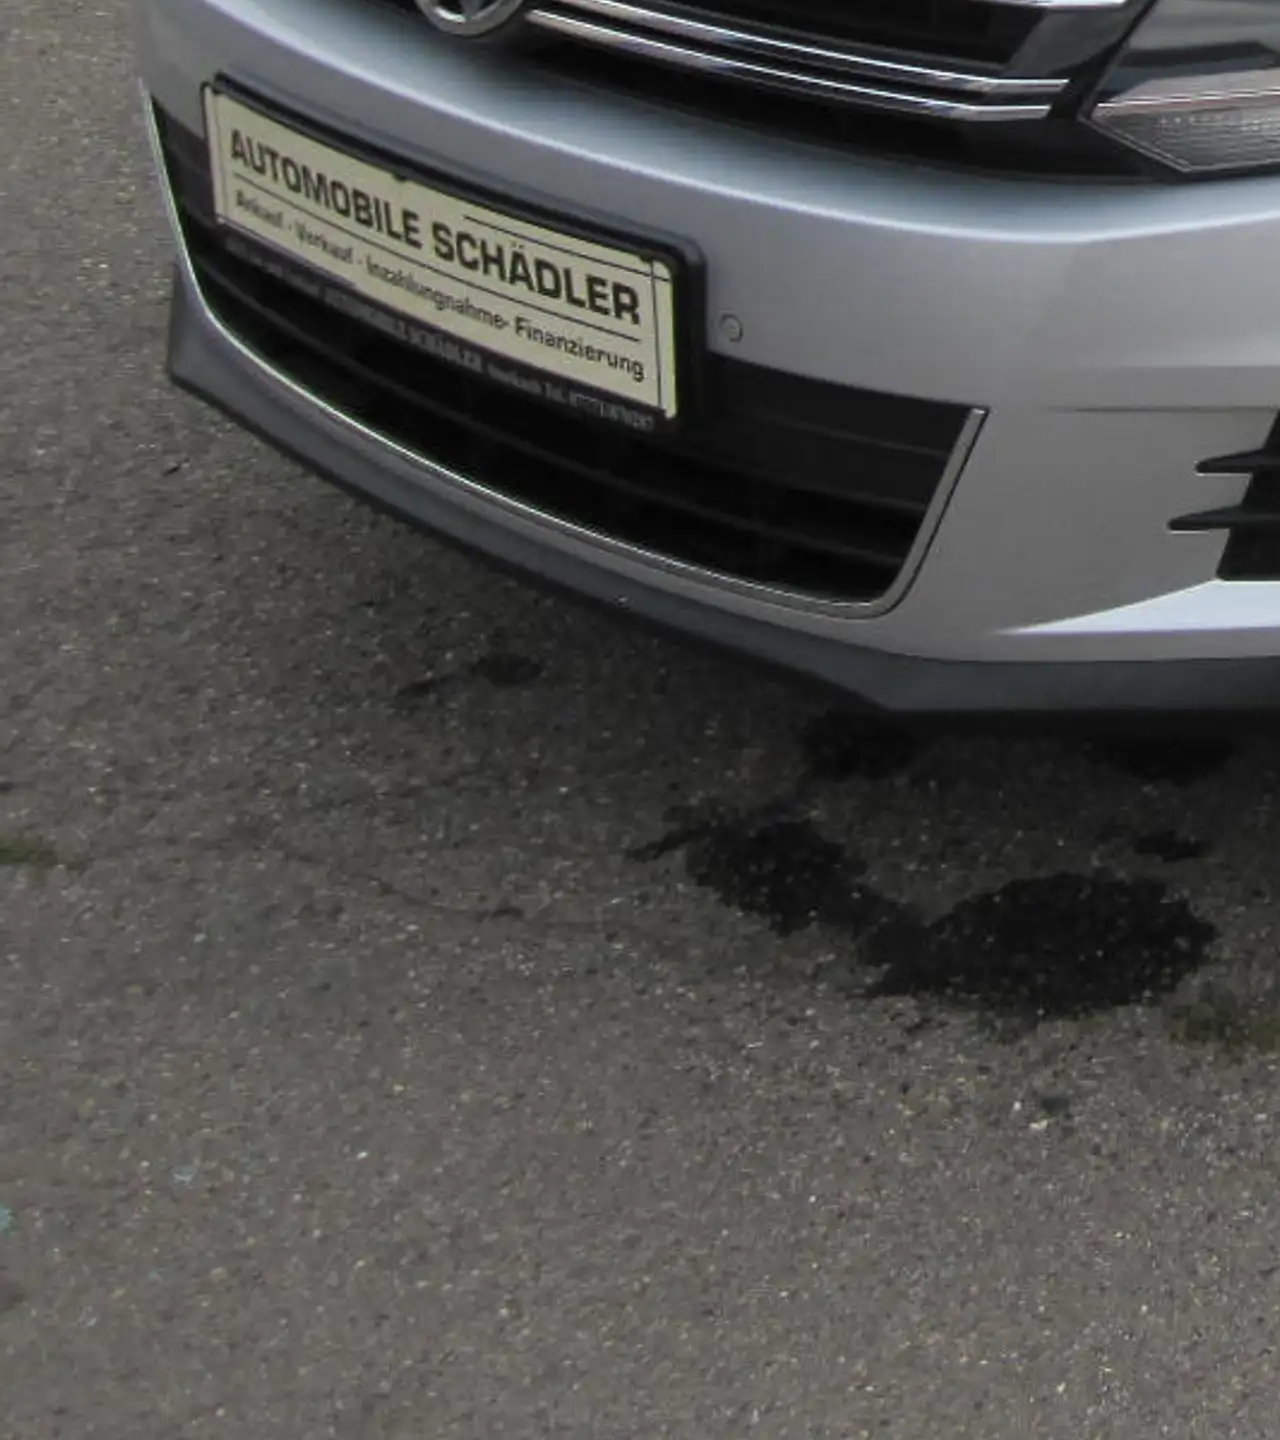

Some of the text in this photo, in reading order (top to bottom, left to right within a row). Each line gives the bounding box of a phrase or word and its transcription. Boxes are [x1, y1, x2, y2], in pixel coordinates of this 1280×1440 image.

[230, 128, 423, 250] AUTOMOBILE
[431, 221, 641, 326] SCHÄDLER
[514, 316, 645, 383] Finanzierung
